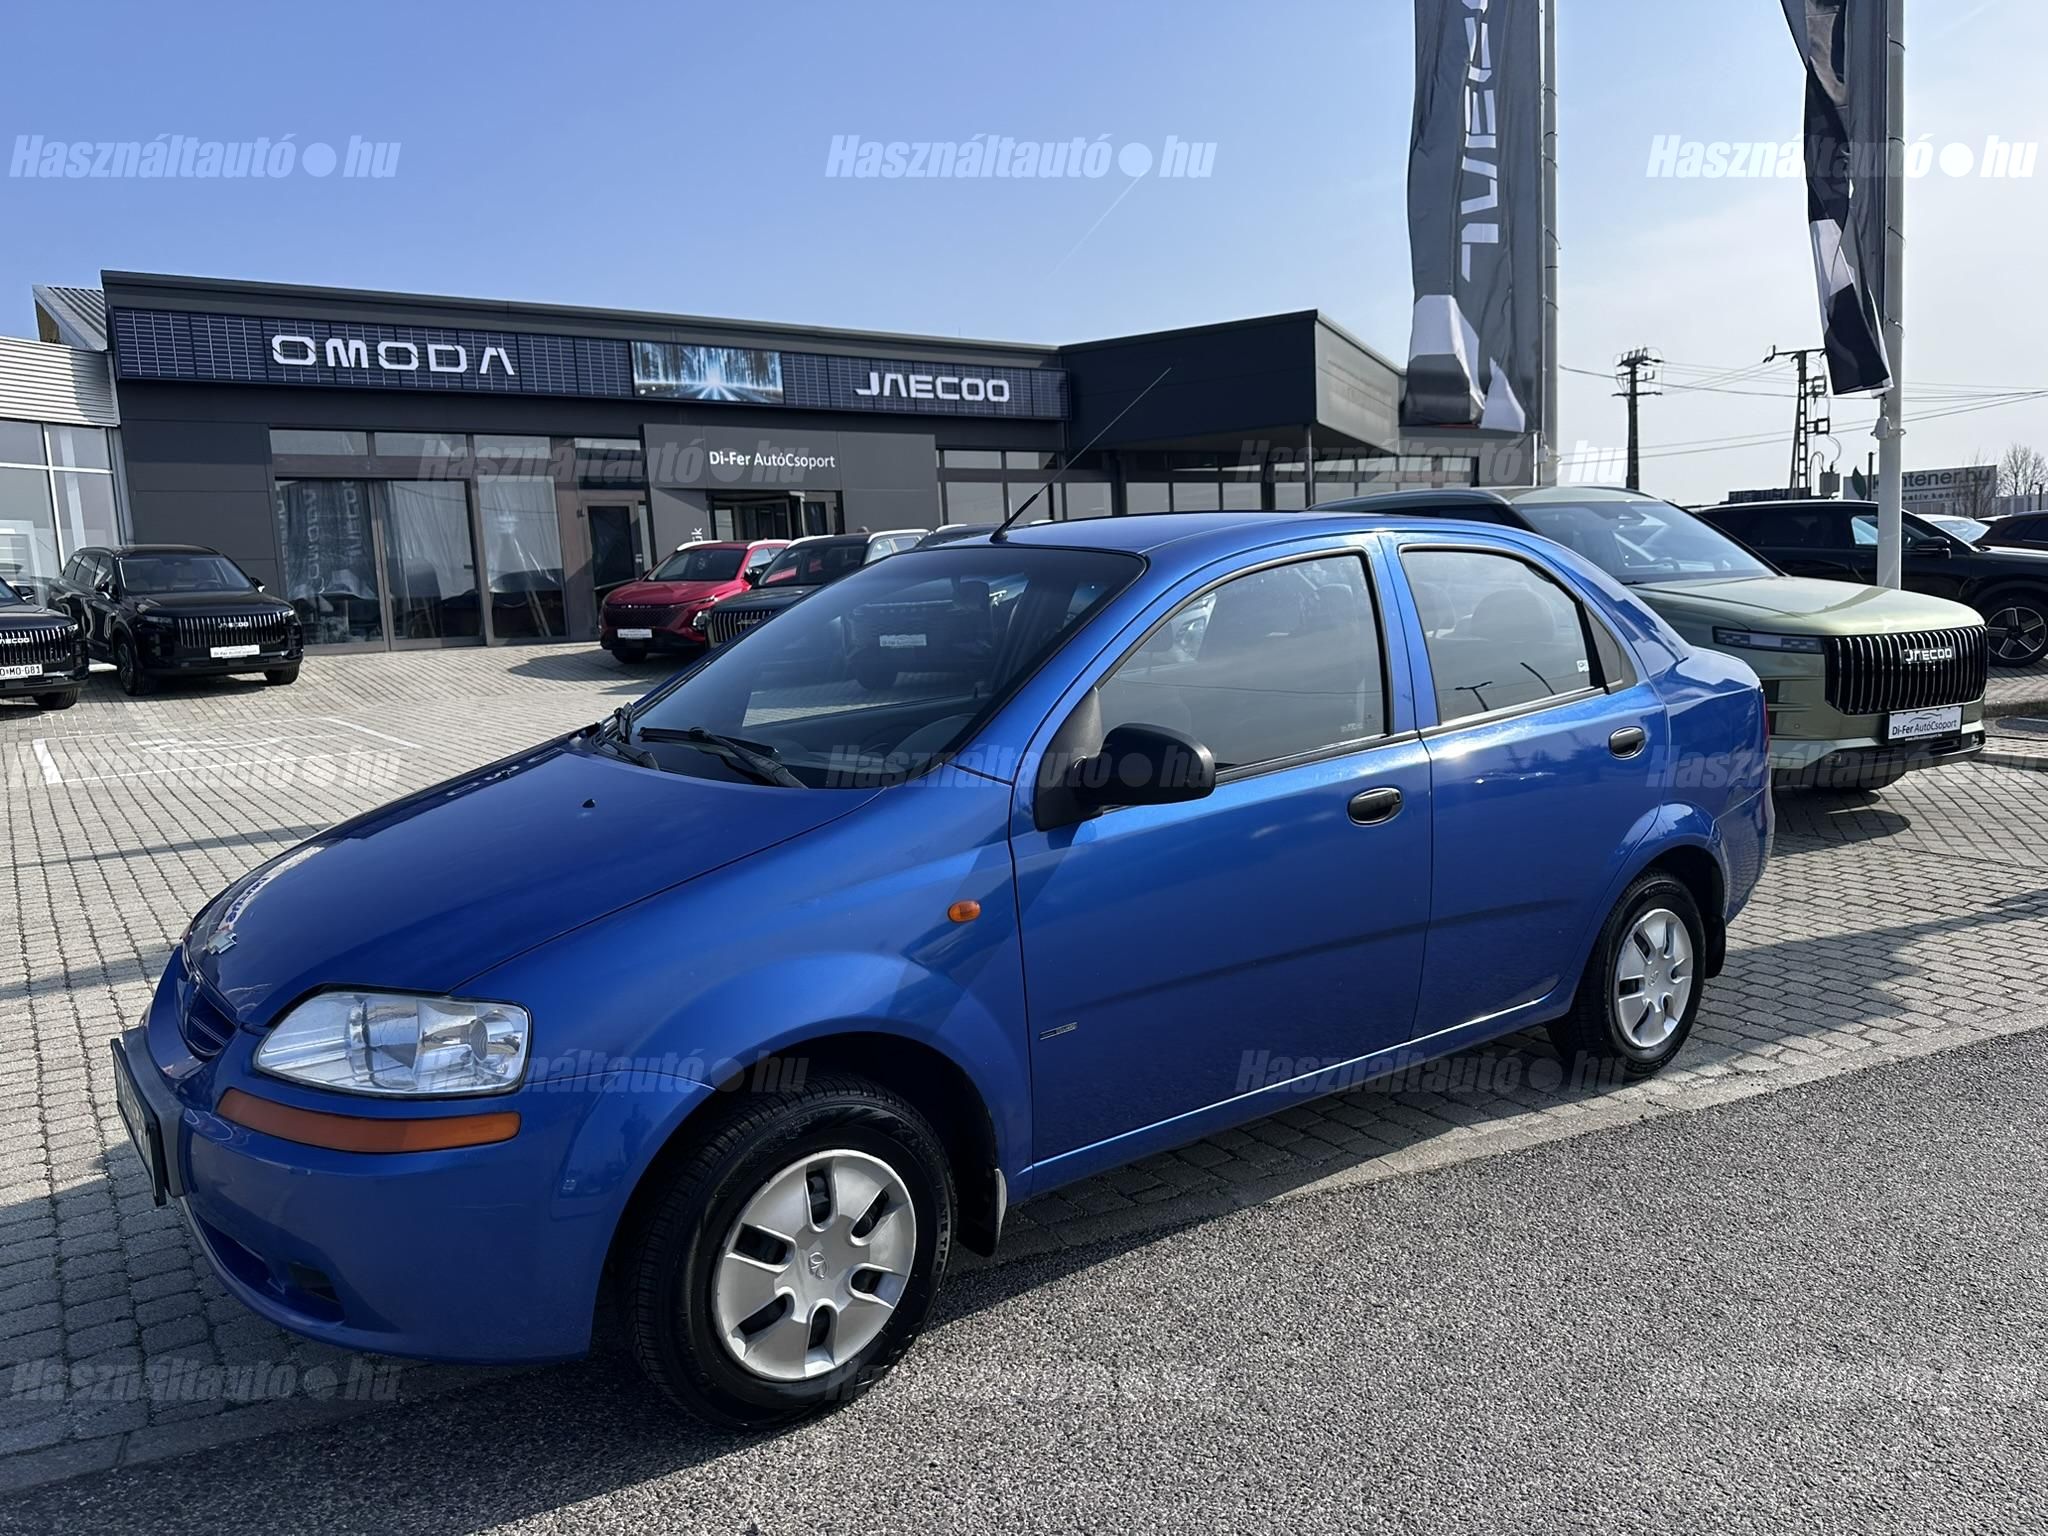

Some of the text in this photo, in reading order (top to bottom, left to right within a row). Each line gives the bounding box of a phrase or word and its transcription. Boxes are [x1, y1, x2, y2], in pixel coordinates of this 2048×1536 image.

[271, 335, 515, 376] OMODA
[855, 371, 1010, 402] JAECOO
[709, 451, 836, 469] Di-Fer AutóCsoport
[1904, 648, 1953, 662] JAECOO
[1892, 720, 1957, 736] Di-Fer AutóCsoport
